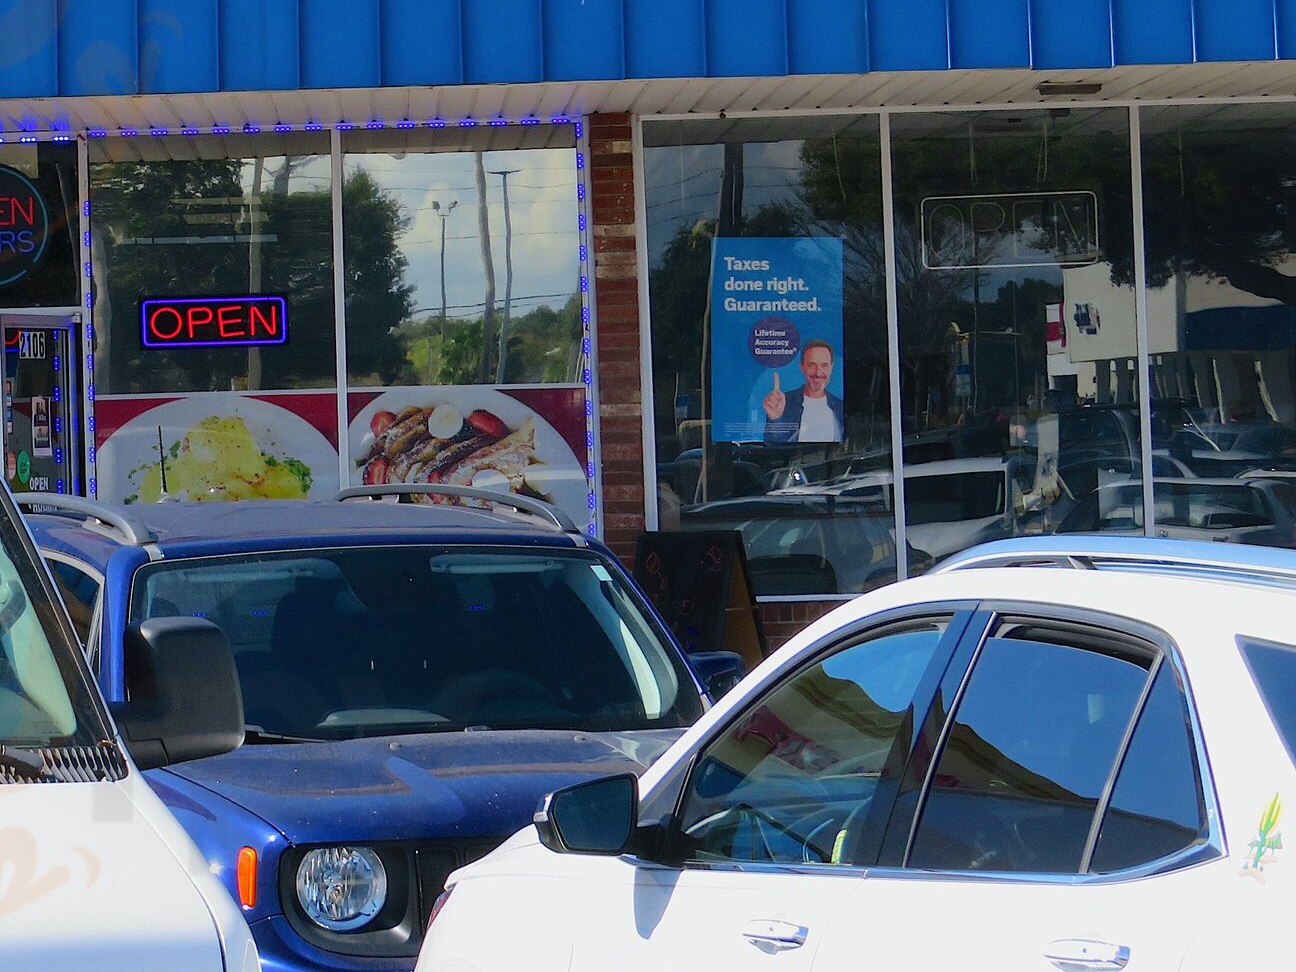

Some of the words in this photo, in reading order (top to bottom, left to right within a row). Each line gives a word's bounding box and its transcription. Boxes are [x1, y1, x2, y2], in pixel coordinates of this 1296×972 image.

[724, 257, 770, 271] Taxes
[724, 277, 763, 291] done
[766, 277, 809, 294] right.
[724, 297, 822, 312] Guaranteed.
[150, 305, 277, 339] OPEN
[754, 329, 786, 337] Lifetime
[20, 332, 45, 358] 2106
[754, 339, 789, 347] Accuracy
[30, 476, 49, 491] OPEN
